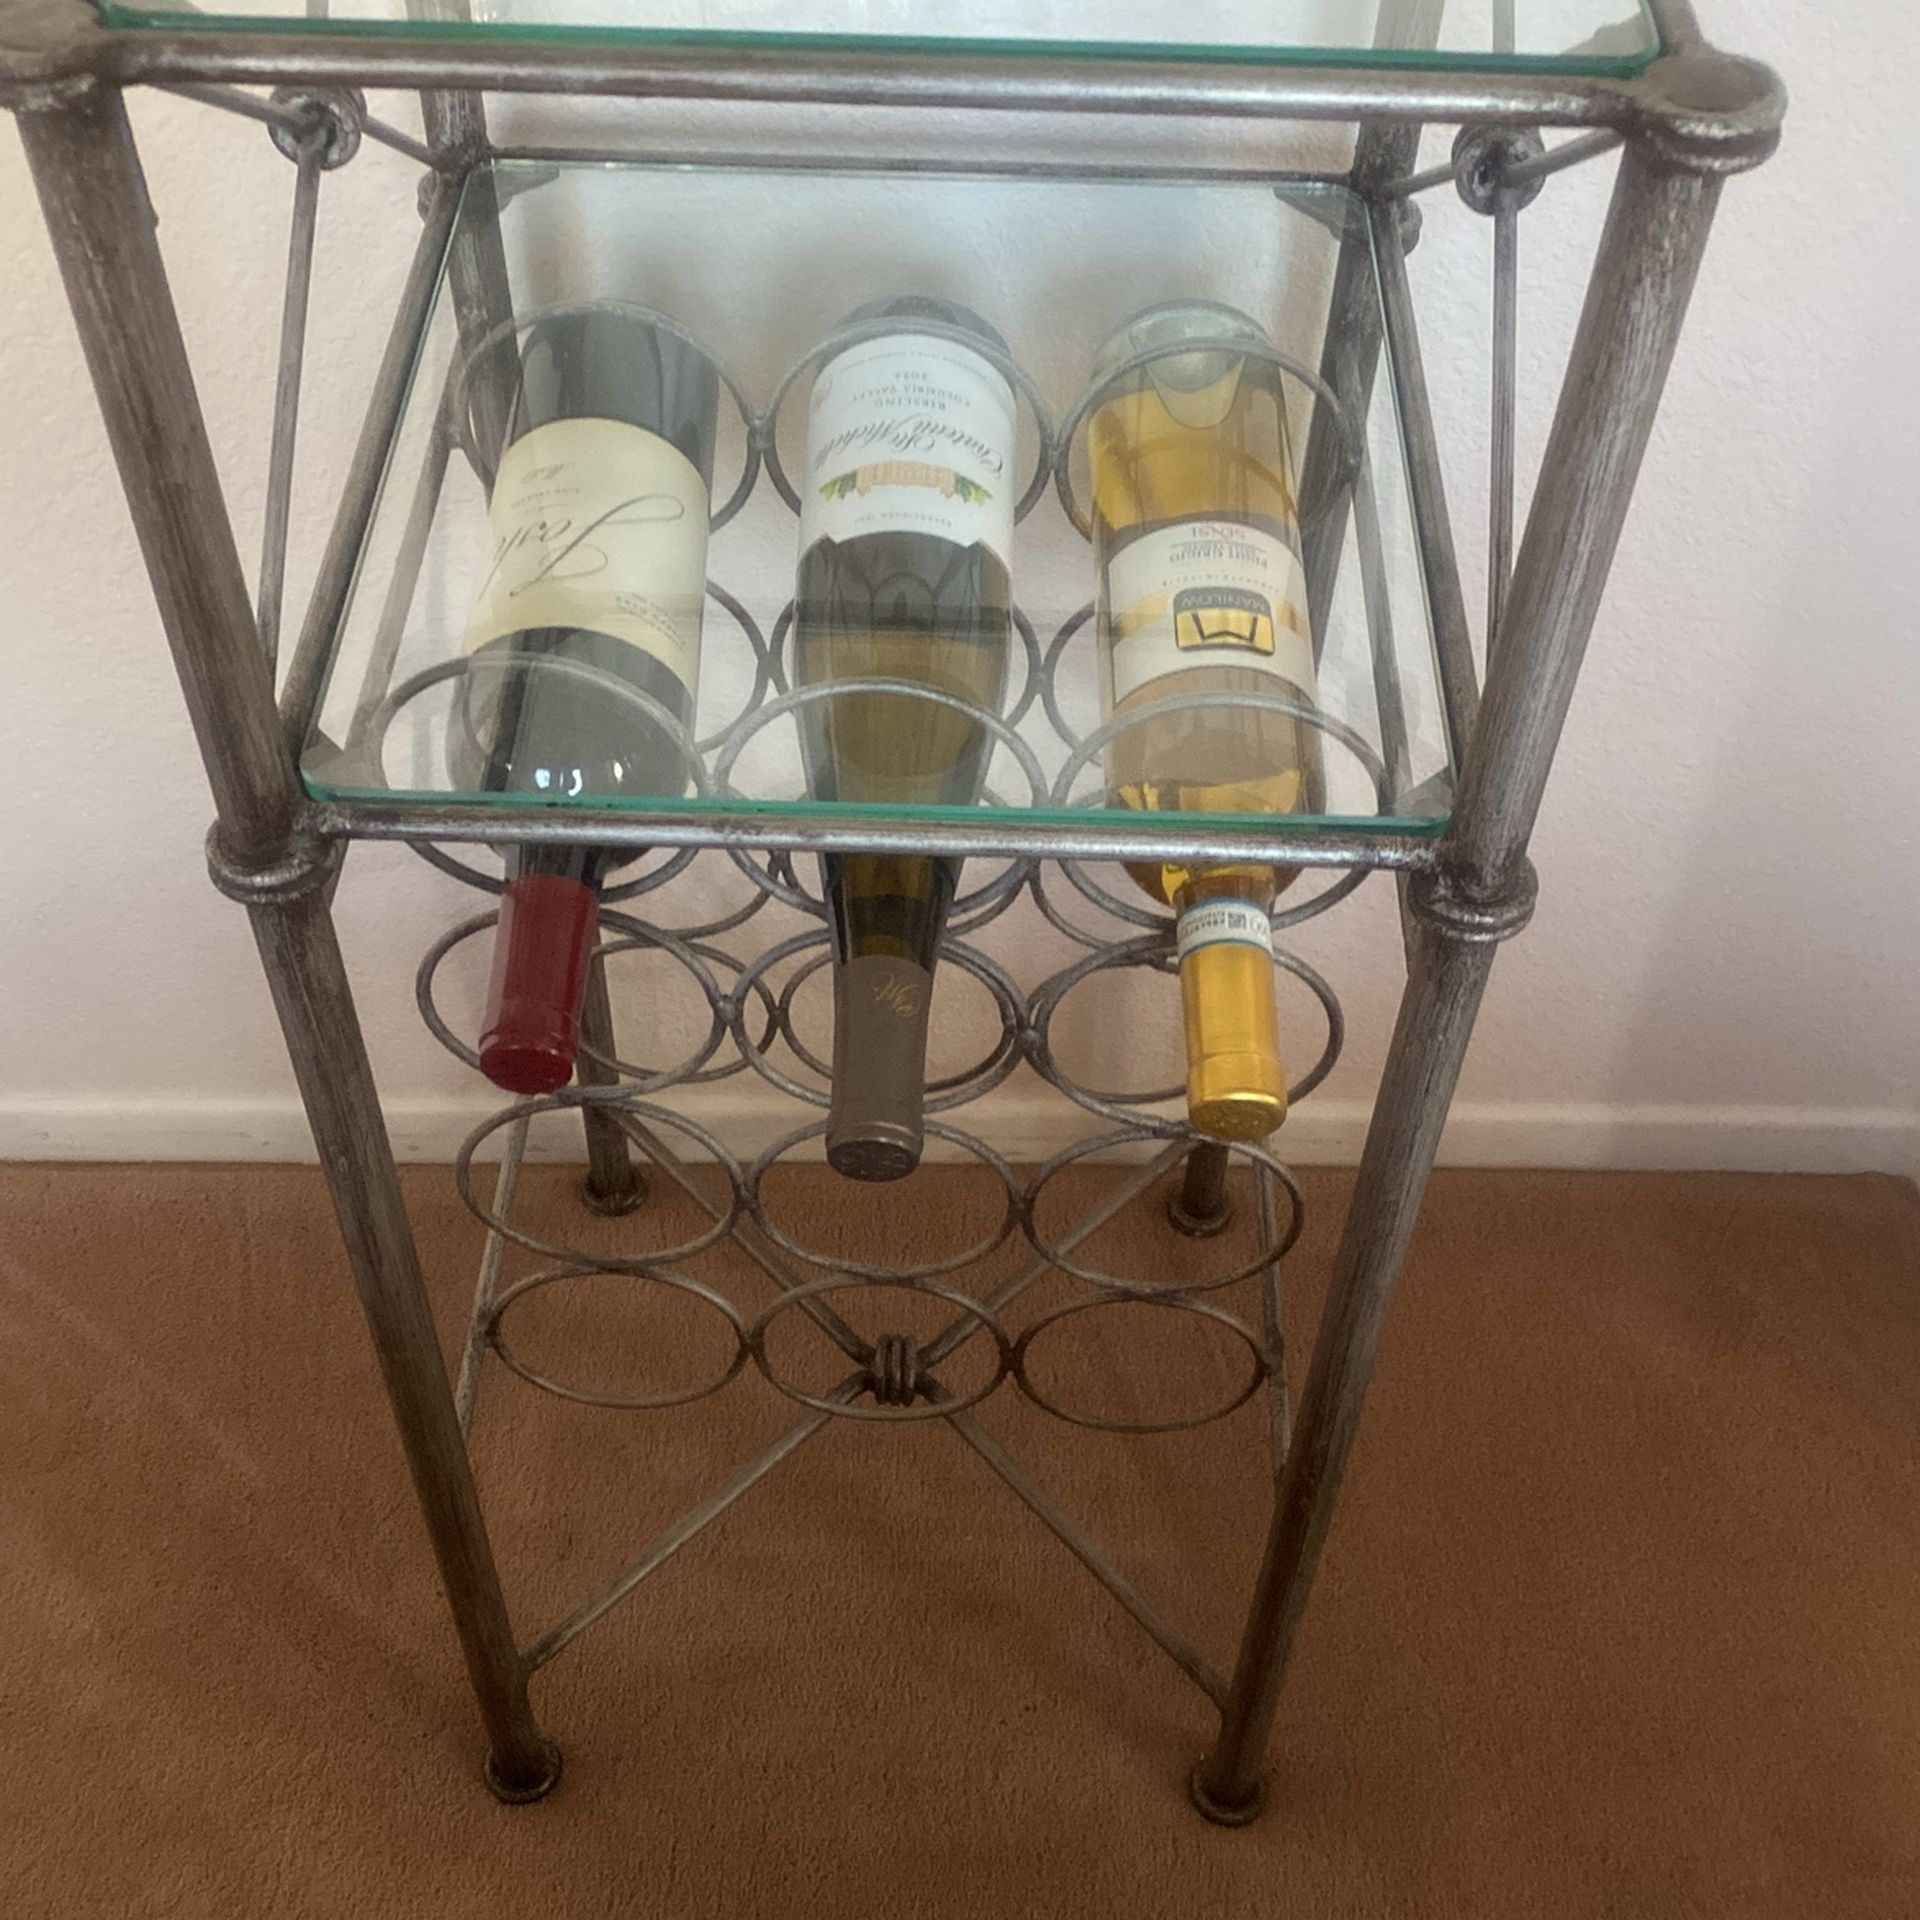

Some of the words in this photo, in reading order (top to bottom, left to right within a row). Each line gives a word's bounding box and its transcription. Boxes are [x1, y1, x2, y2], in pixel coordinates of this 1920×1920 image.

[851, 383, 897, 403] VALLEY
[903, 384, 971, 408] COLUMBIA
[873, 397, 948, 412] RIESLING
[1192, 526, 1246, 541] SENSI
[477, 493, 684, 600] Josh
[1169, 551, 1224, 564] GRIGIO
[1228, 551, 1269, 571] PINOT
[1180, 592, 1266, 612] MANILOW
